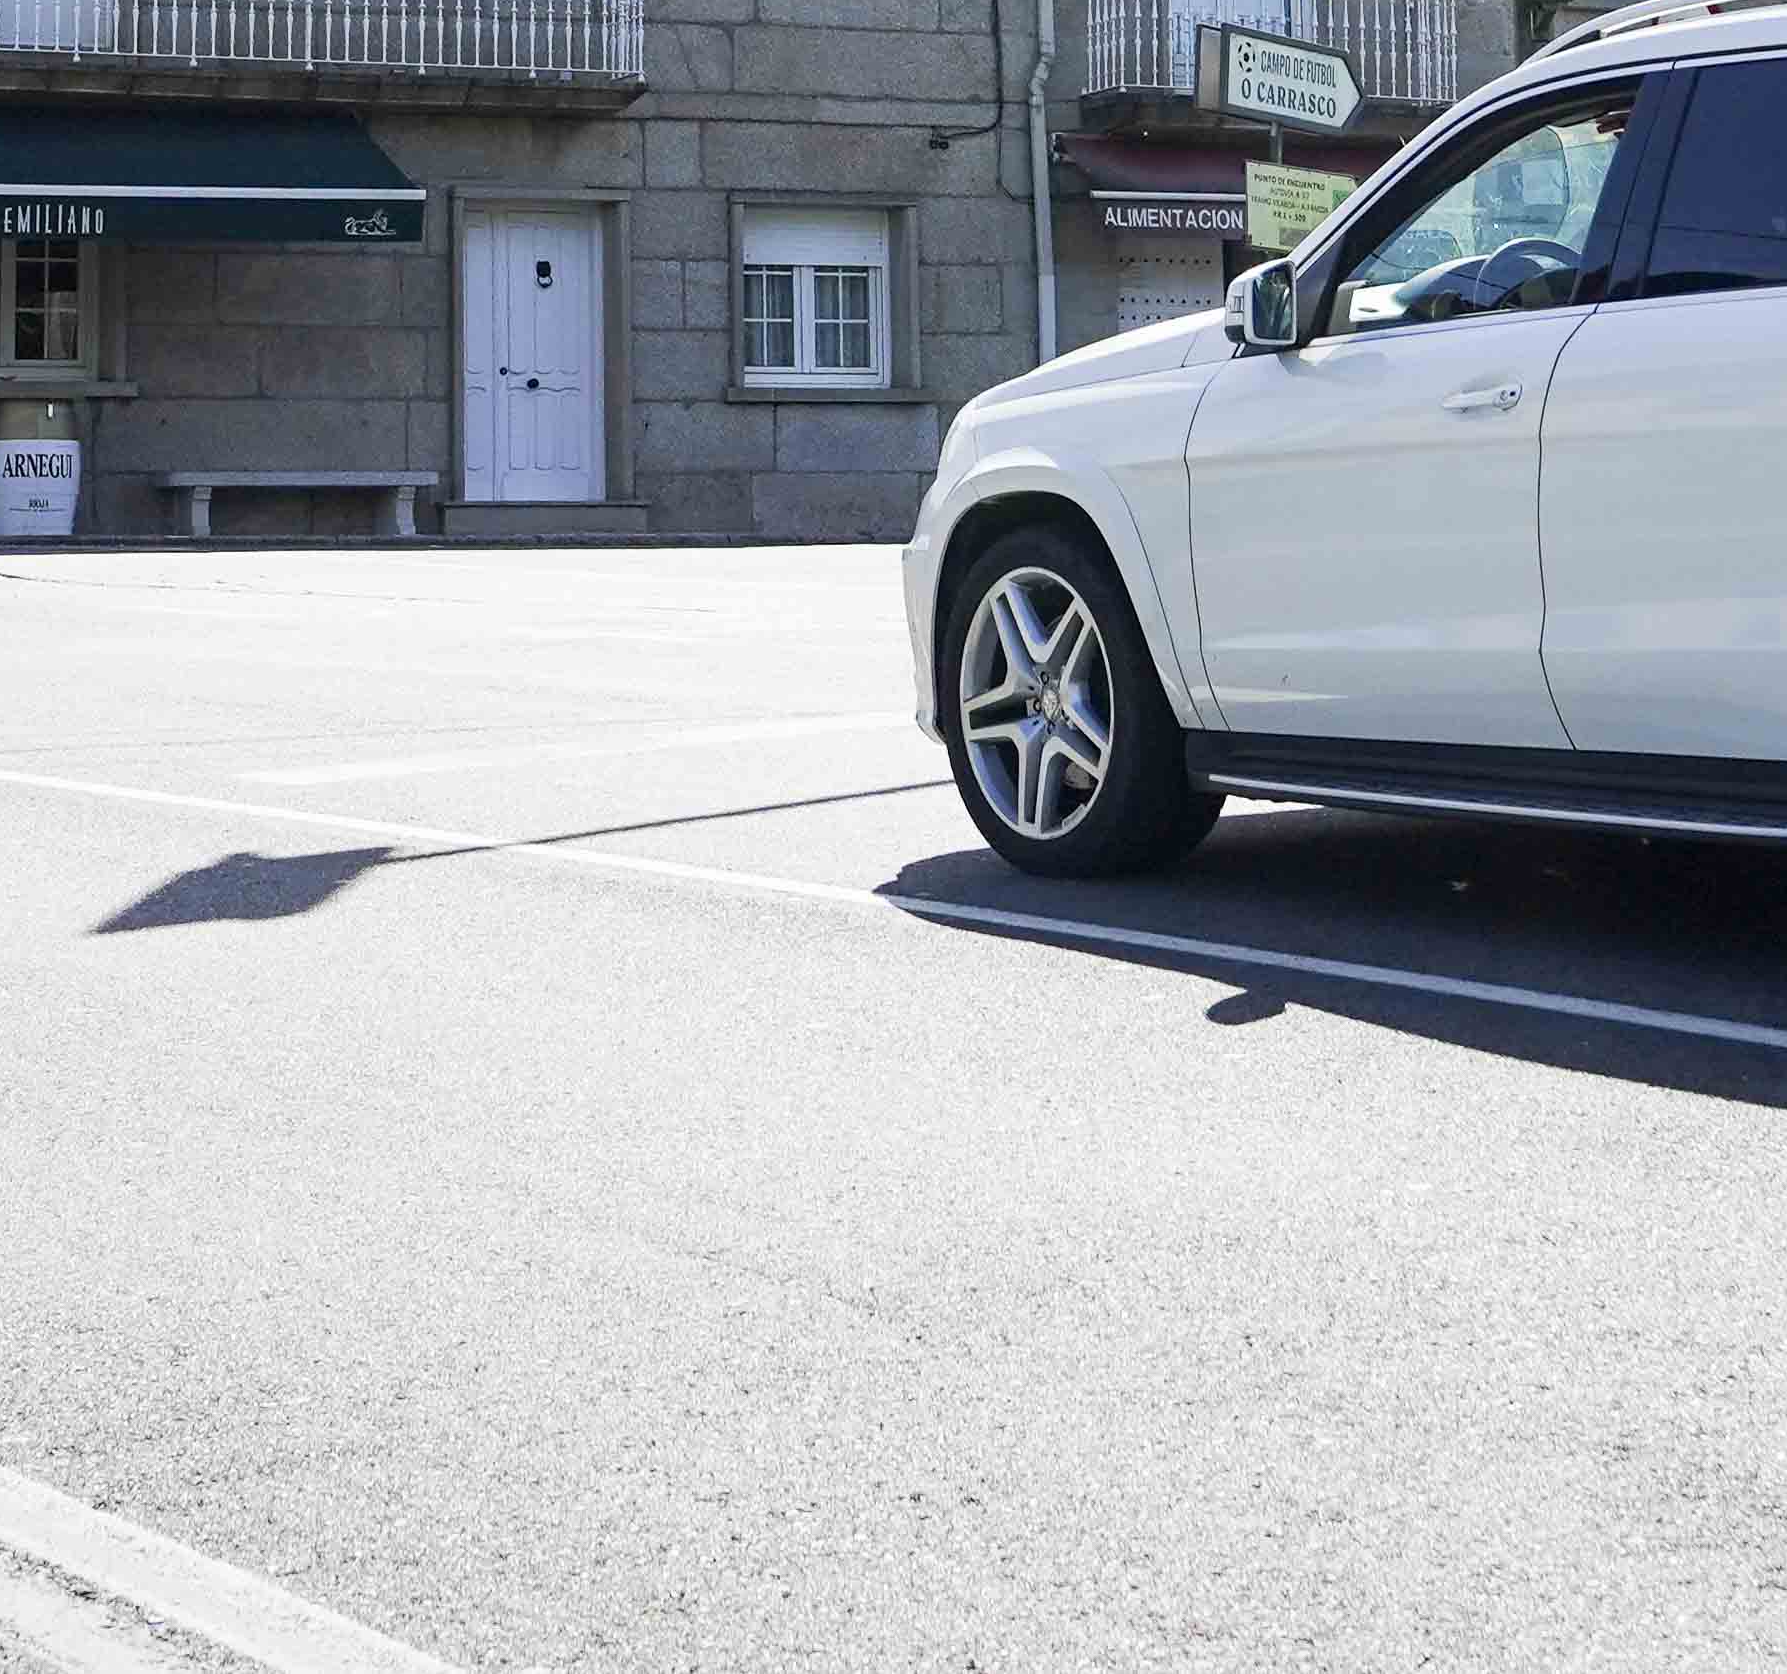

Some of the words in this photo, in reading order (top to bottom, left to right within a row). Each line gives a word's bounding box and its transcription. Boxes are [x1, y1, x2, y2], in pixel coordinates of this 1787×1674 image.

[1260, 50, 1291, 77] CAMPO
[1293, 57, 1305, 81] DE
[1306, 61, 1337, 88] FUTBOL
[1241, 77, 1252, 100] O
[1257, 81, 1337, 119] CARRASCO
[3, 204, 105, 235] EMILIANO
[1104, 206, 1244, 230] ALIMENTACION
